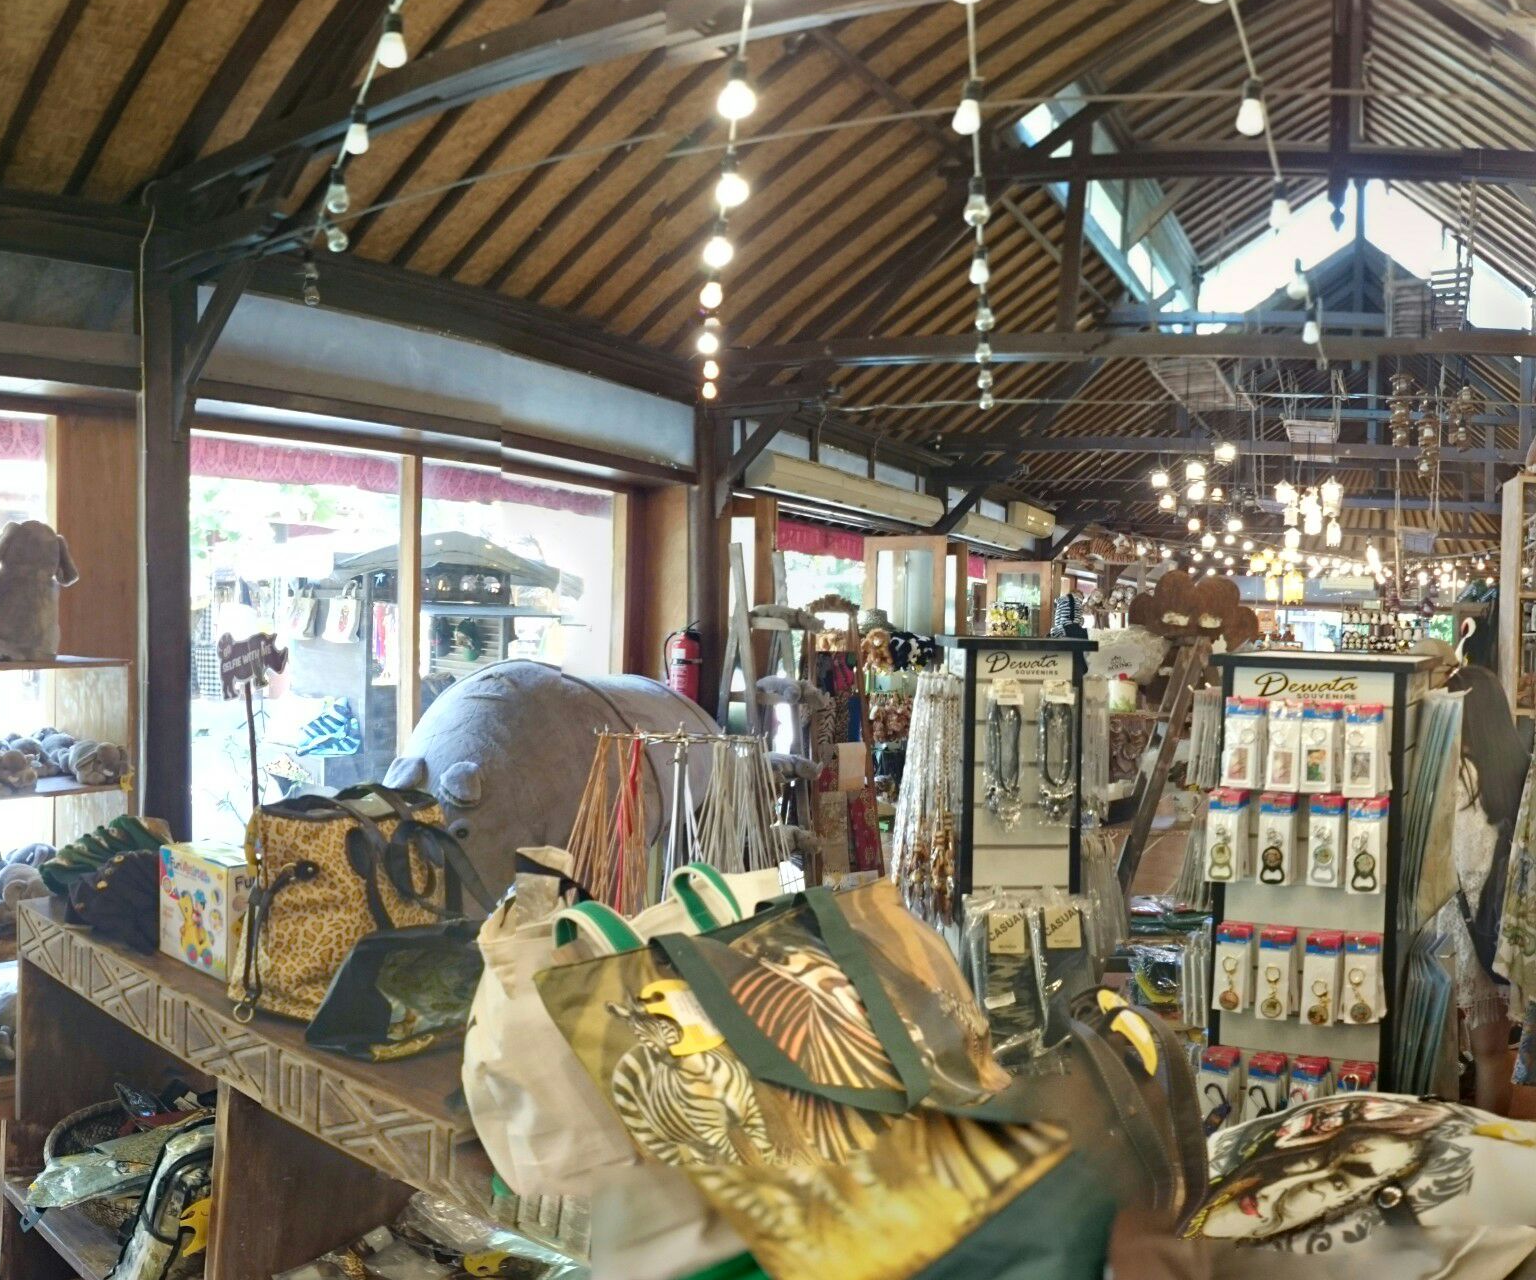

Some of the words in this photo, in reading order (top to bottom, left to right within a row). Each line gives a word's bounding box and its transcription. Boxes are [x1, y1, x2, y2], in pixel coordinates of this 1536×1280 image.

[222, 656, 242, 673] SELFIE
[242, 648, 260, 664] WITH
[985, 651, 1060, 674] Dewata
[1254, 671, 1358, 697] Dewata
[234, 875, 255, 892] Fu
[989, 911, 1026, 942] CASUAL
[1045, 907, 1080, 937] CASUAL
